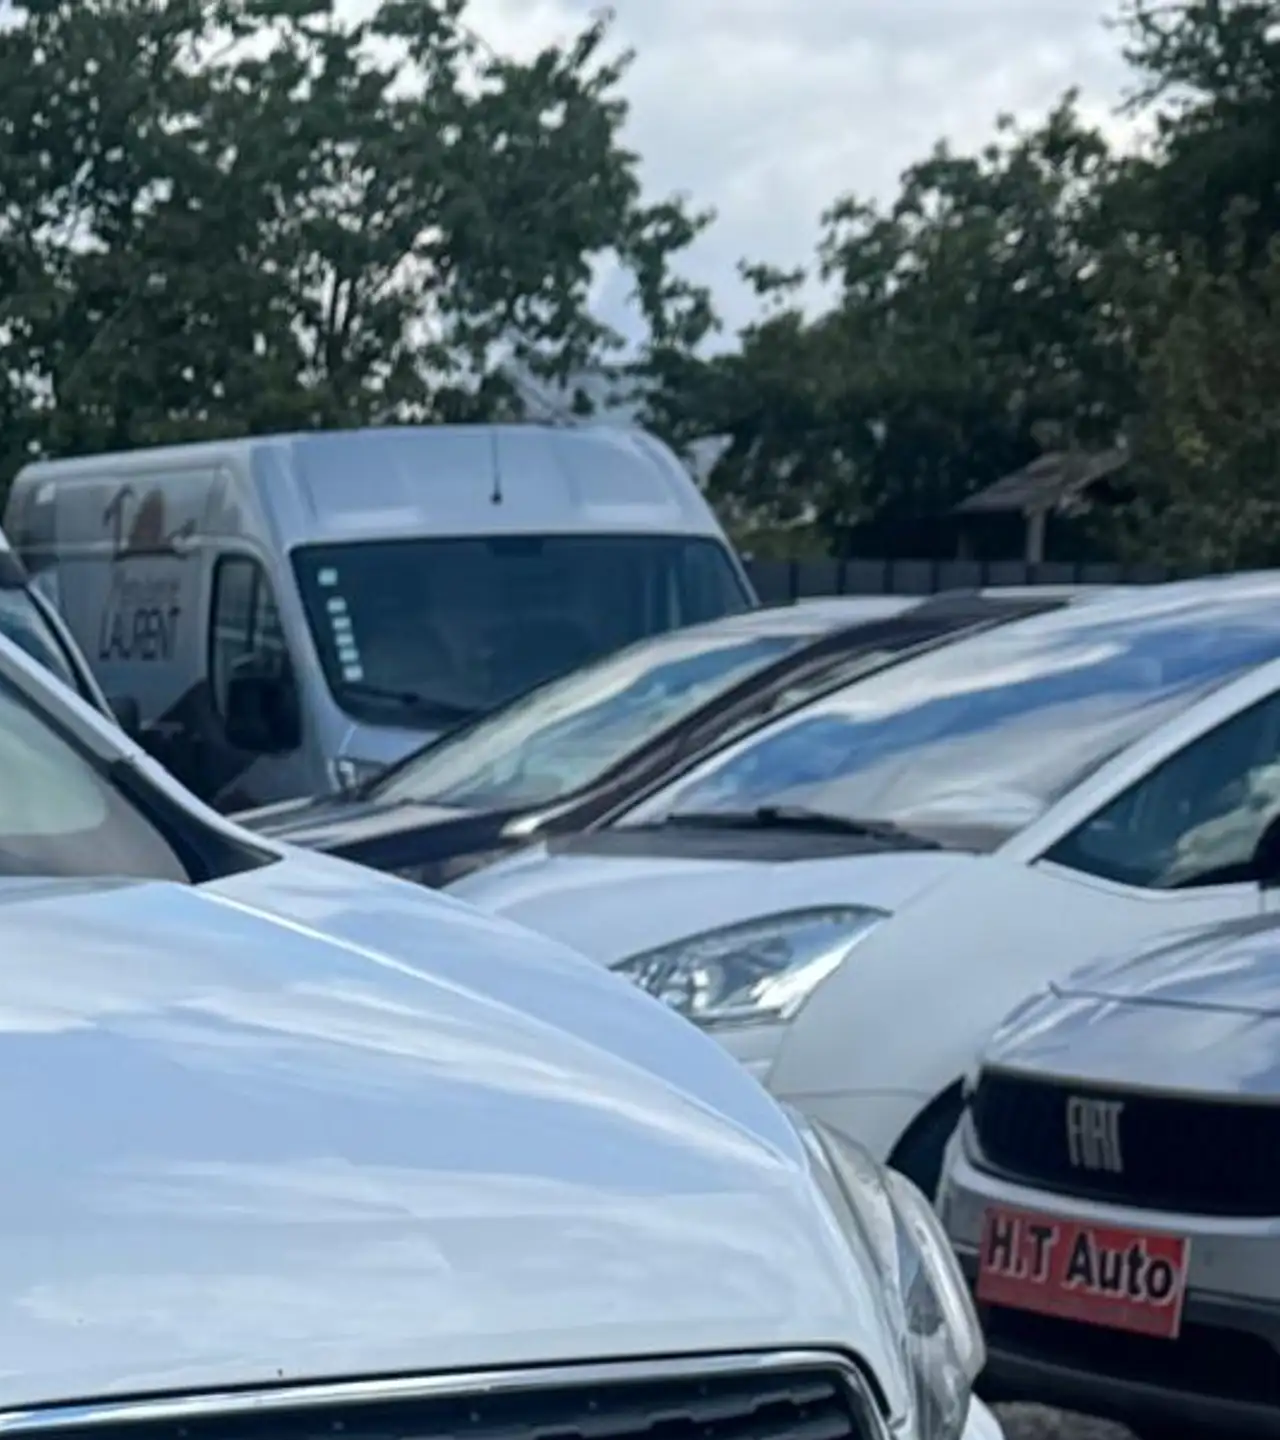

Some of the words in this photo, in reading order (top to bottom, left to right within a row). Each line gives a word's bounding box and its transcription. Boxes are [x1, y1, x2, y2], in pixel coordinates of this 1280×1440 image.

[1066, 1095, 1125, 1173] FIAT
[987, 1213, 1060, 1284] H.T
[1060, 1228, 1176, 1306] Auto
